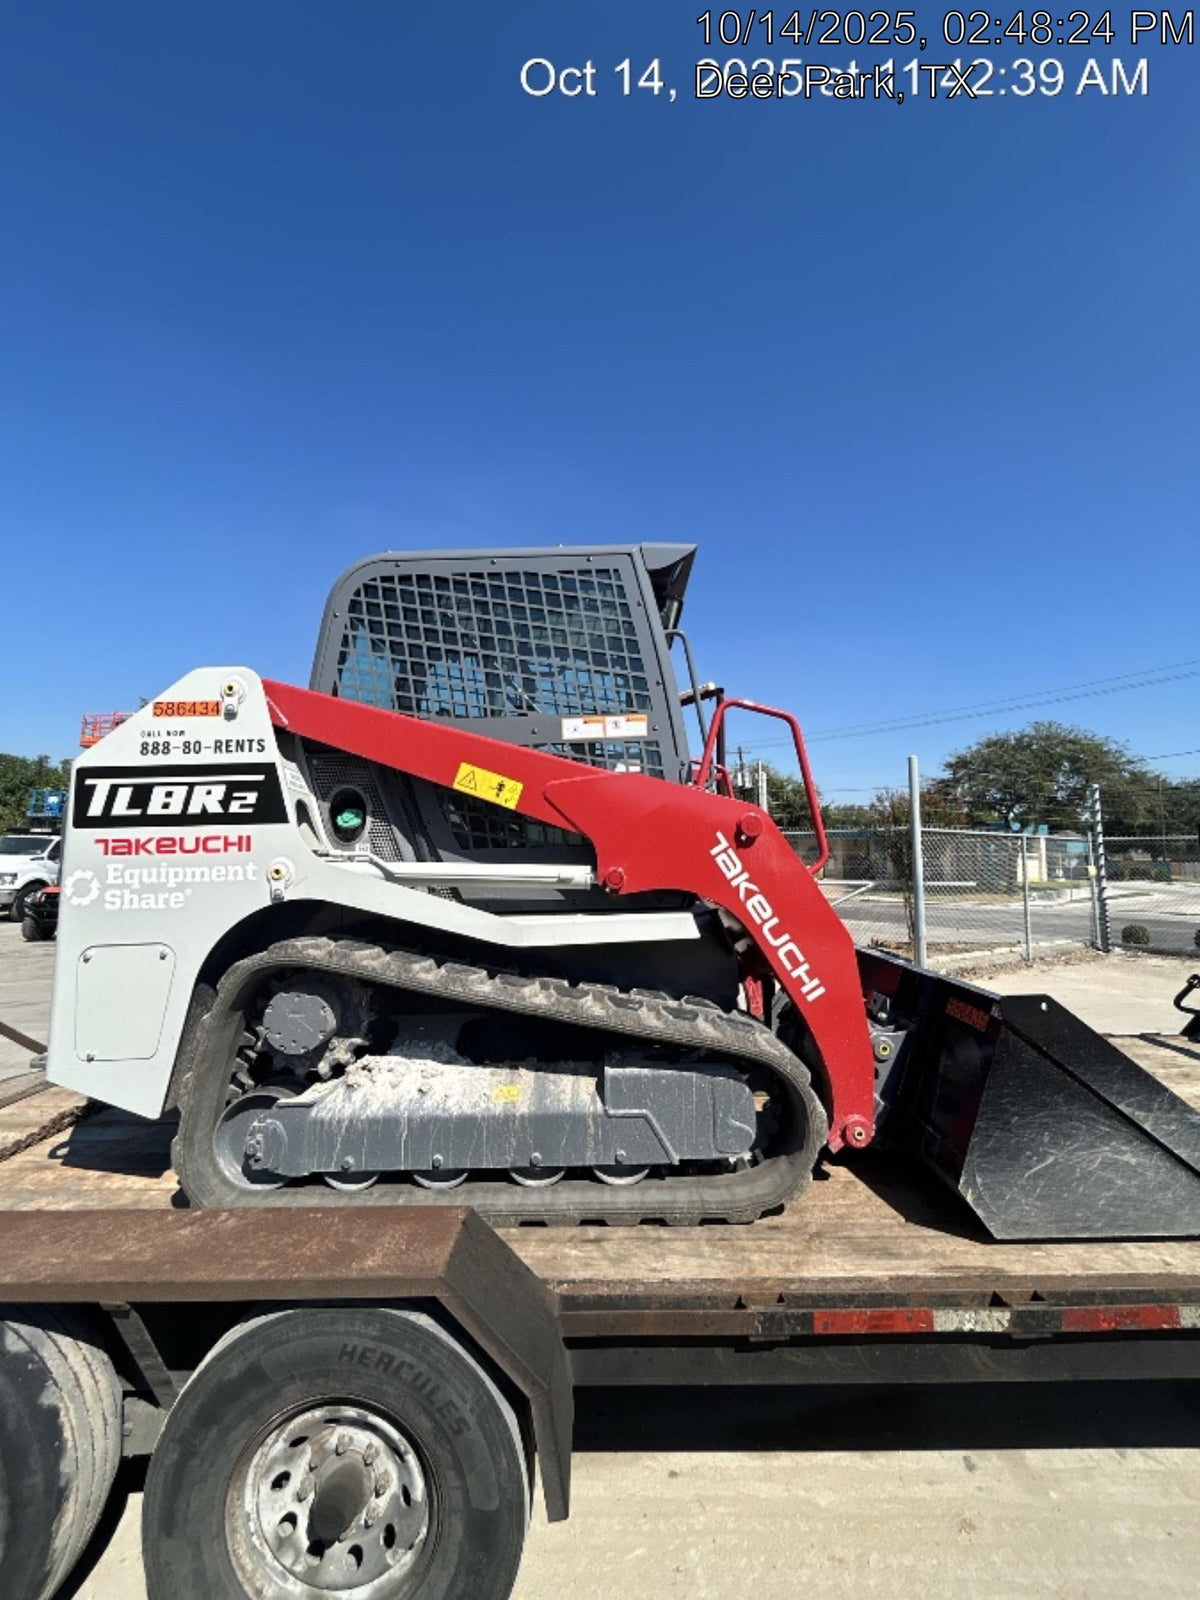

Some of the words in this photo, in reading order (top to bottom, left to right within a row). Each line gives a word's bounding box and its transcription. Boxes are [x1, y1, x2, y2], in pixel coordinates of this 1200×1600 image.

[153, 701, 220, 716] 586434
[139, 738, 266, 756] 888-80-RENTS
[106, 862, 258, 889] Equipment
[337, 1343, 472, 1437] HERCULES
